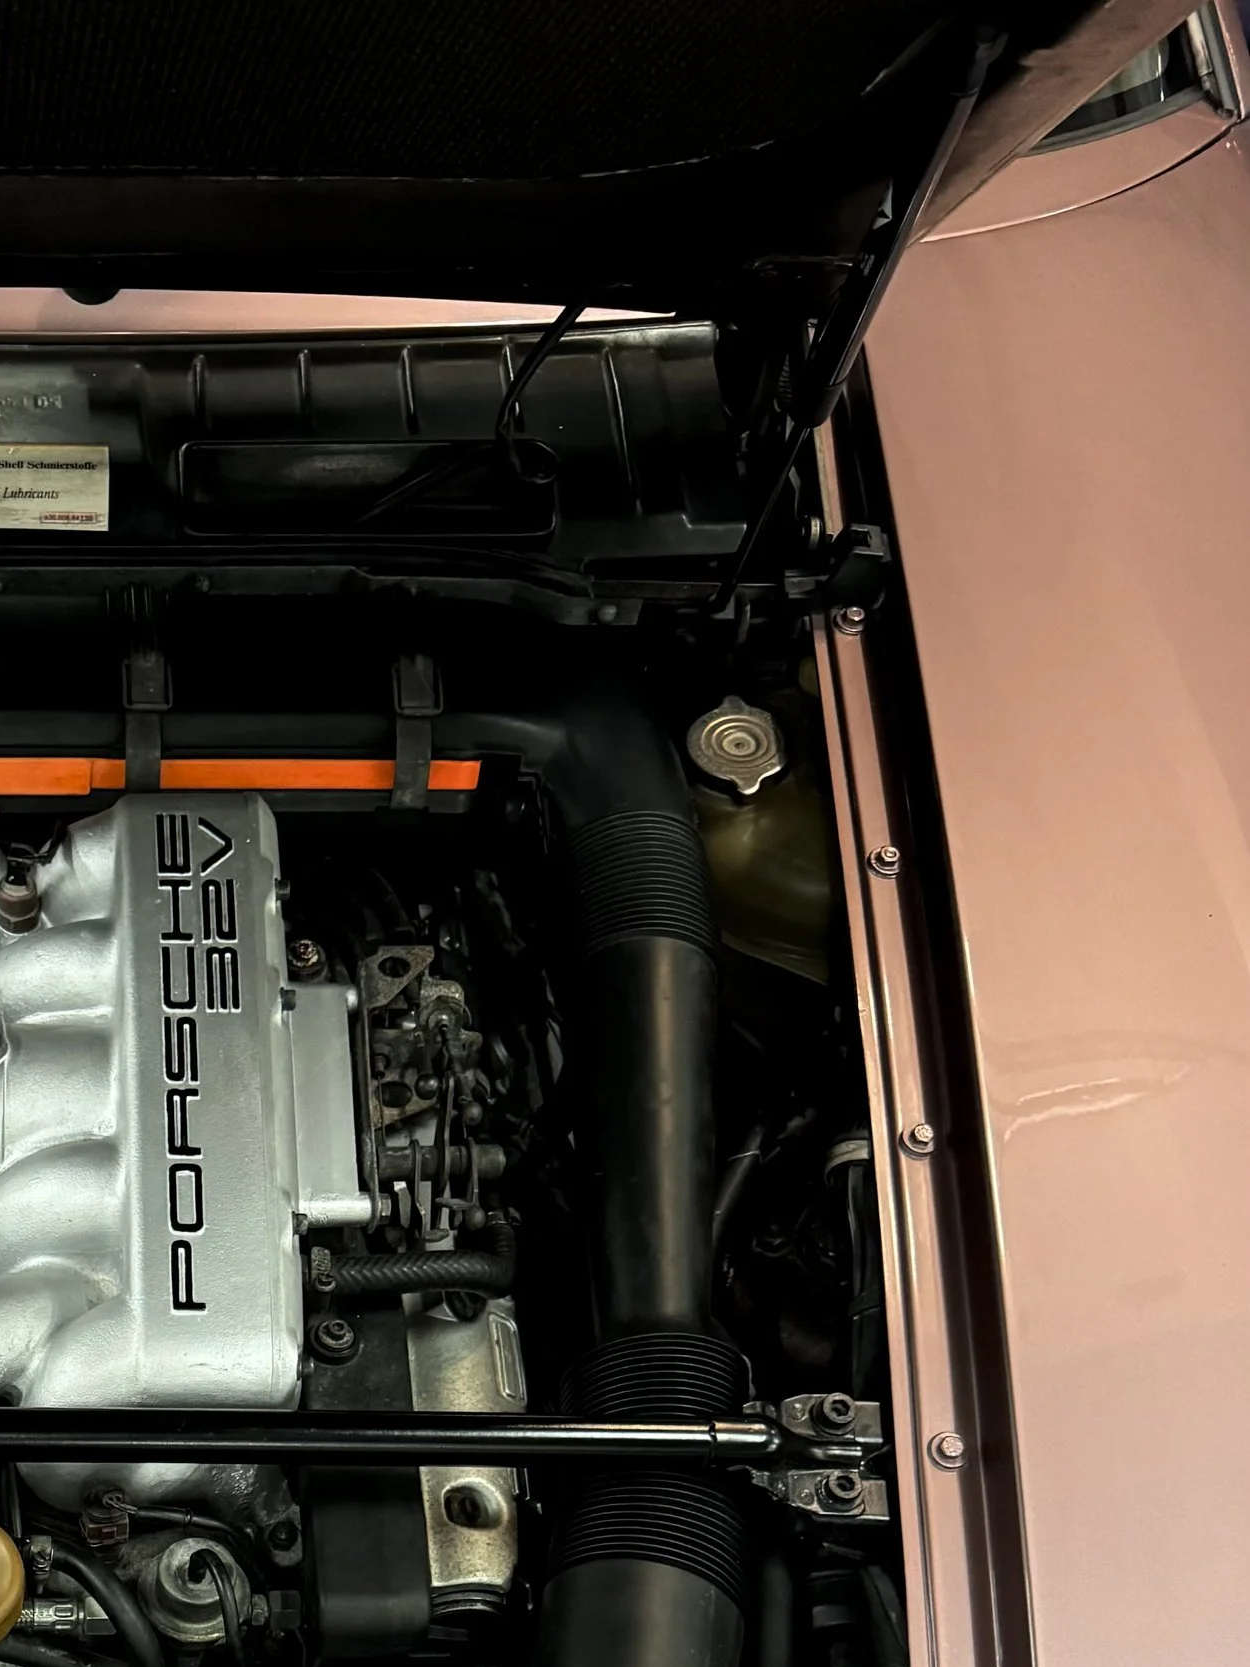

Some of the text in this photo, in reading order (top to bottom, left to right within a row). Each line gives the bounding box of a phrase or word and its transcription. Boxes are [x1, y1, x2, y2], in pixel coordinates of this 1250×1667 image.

[2, 487, 60, 500] Lubricants
[26, 461, 98, 471] Schmierstoffe
[197, 815, 241, 1013] 32V
[156, 812, 208, 1313] PORSCHE
